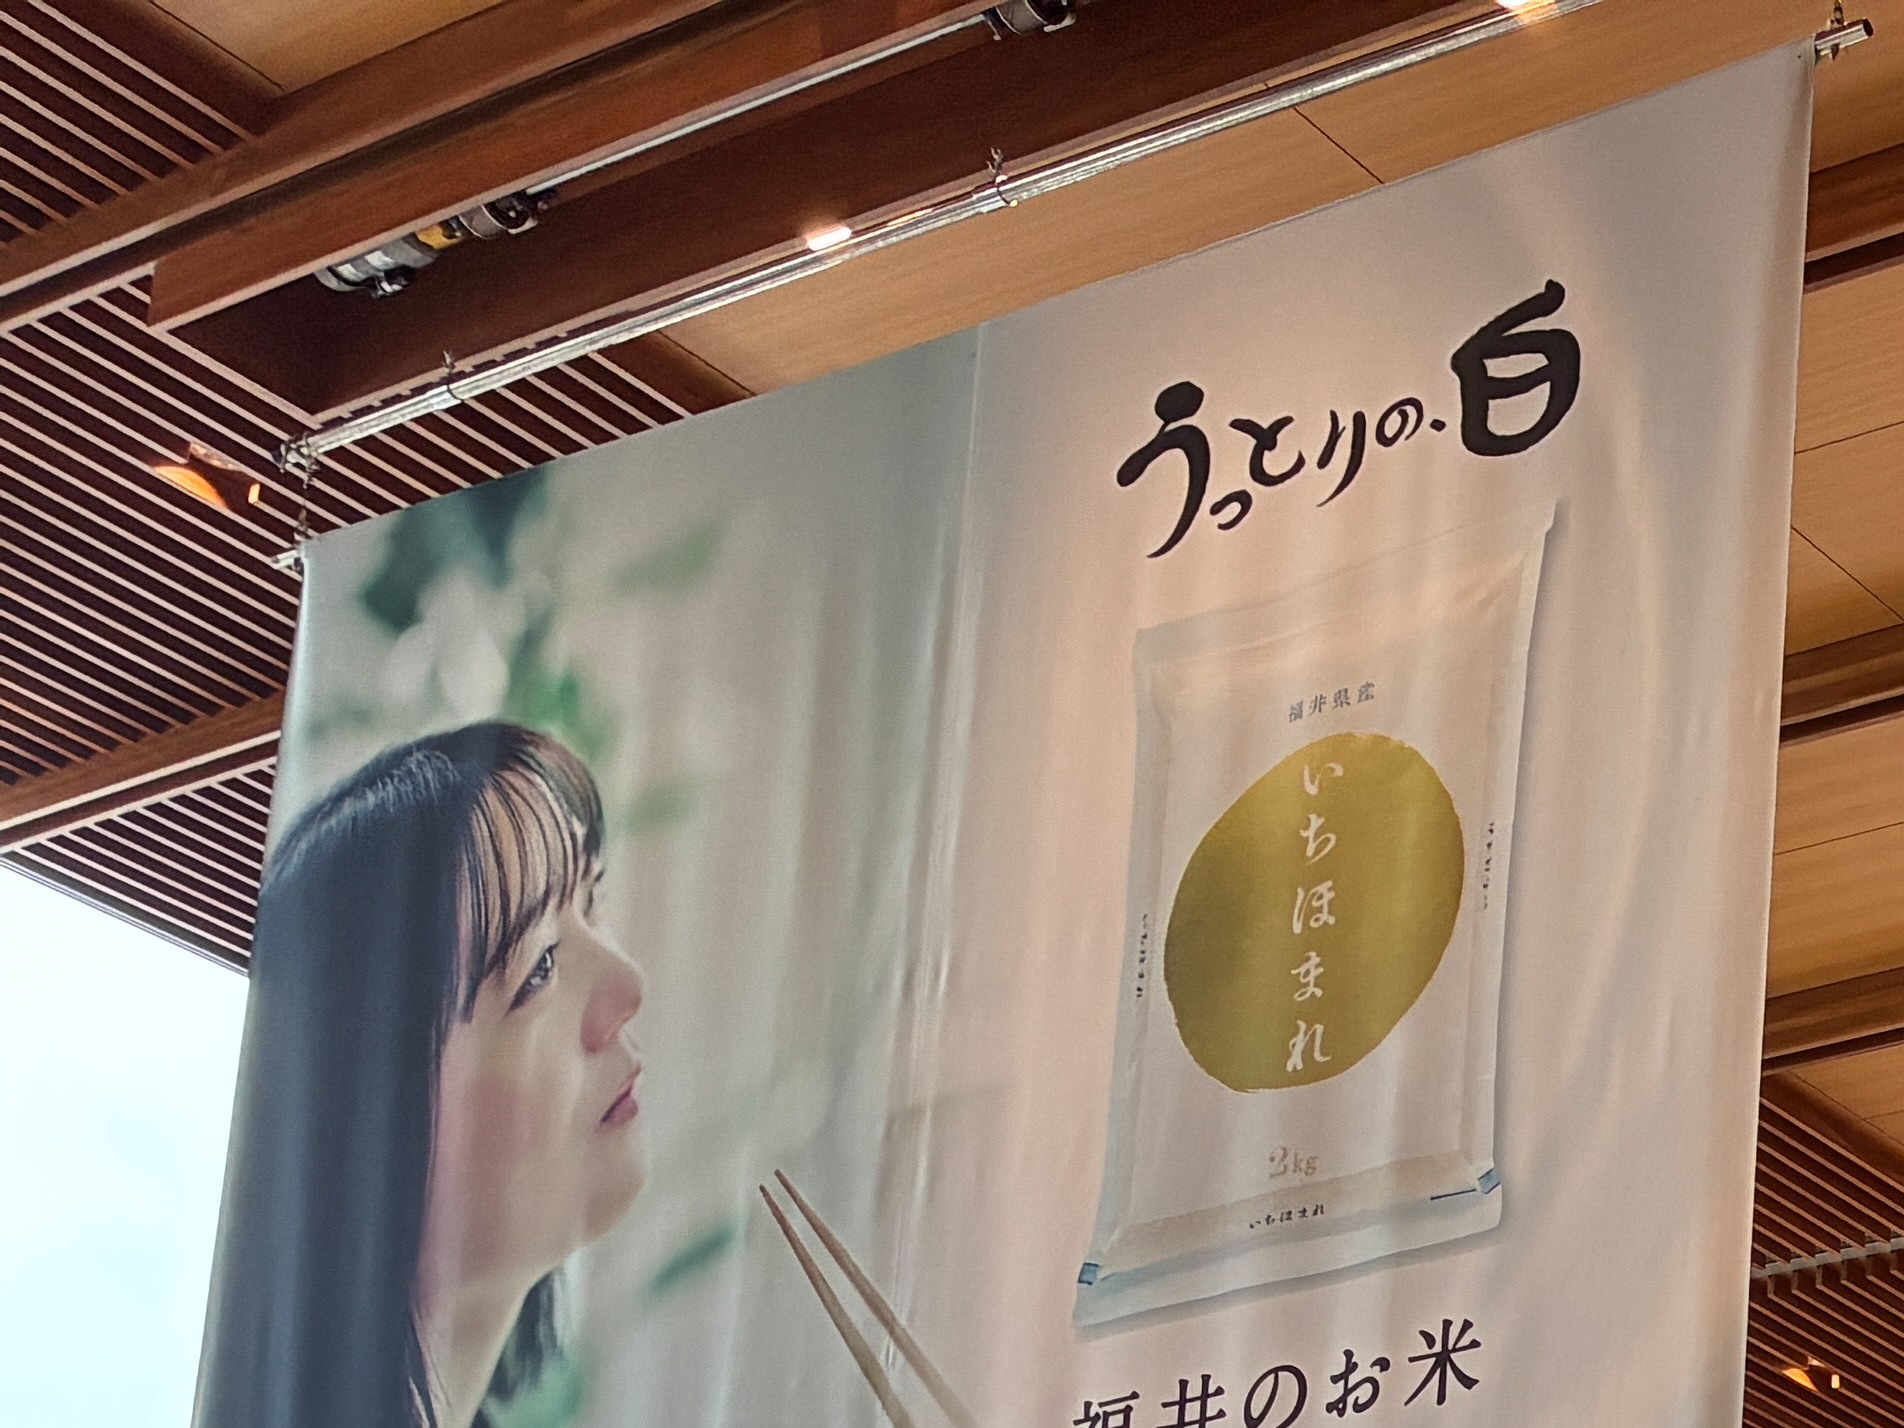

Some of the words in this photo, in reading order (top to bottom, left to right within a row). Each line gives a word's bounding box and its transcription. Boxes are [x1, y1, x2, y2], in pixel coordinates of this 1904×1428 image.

[1285, 760, 1345, 1073] いちほまれ
[1269, 1146, 1318, 1178] 2kg
